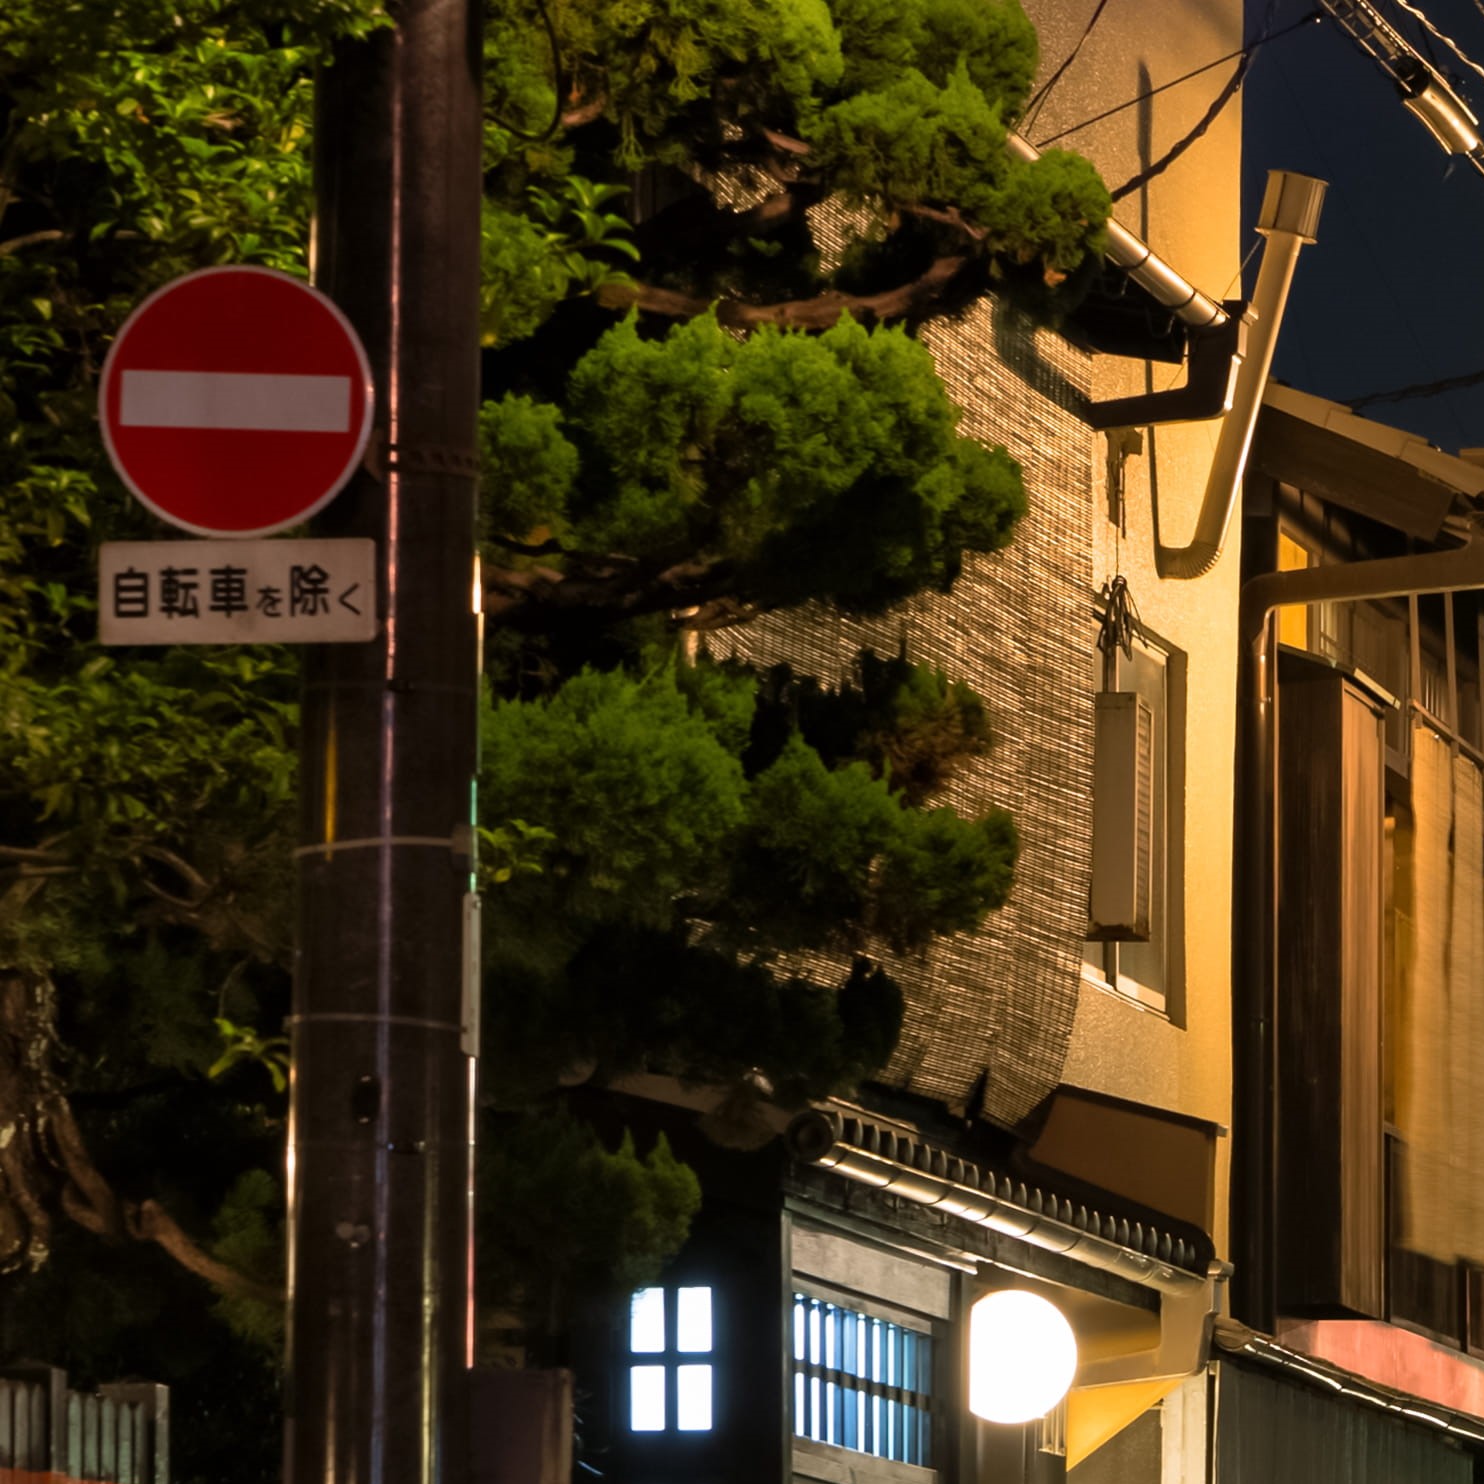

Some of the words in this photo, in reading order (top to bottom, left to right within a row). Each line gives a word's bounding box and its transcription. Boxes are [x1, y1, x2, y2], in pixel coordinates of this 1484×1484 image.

[113, 564, 361, 619] 自転車を除く
